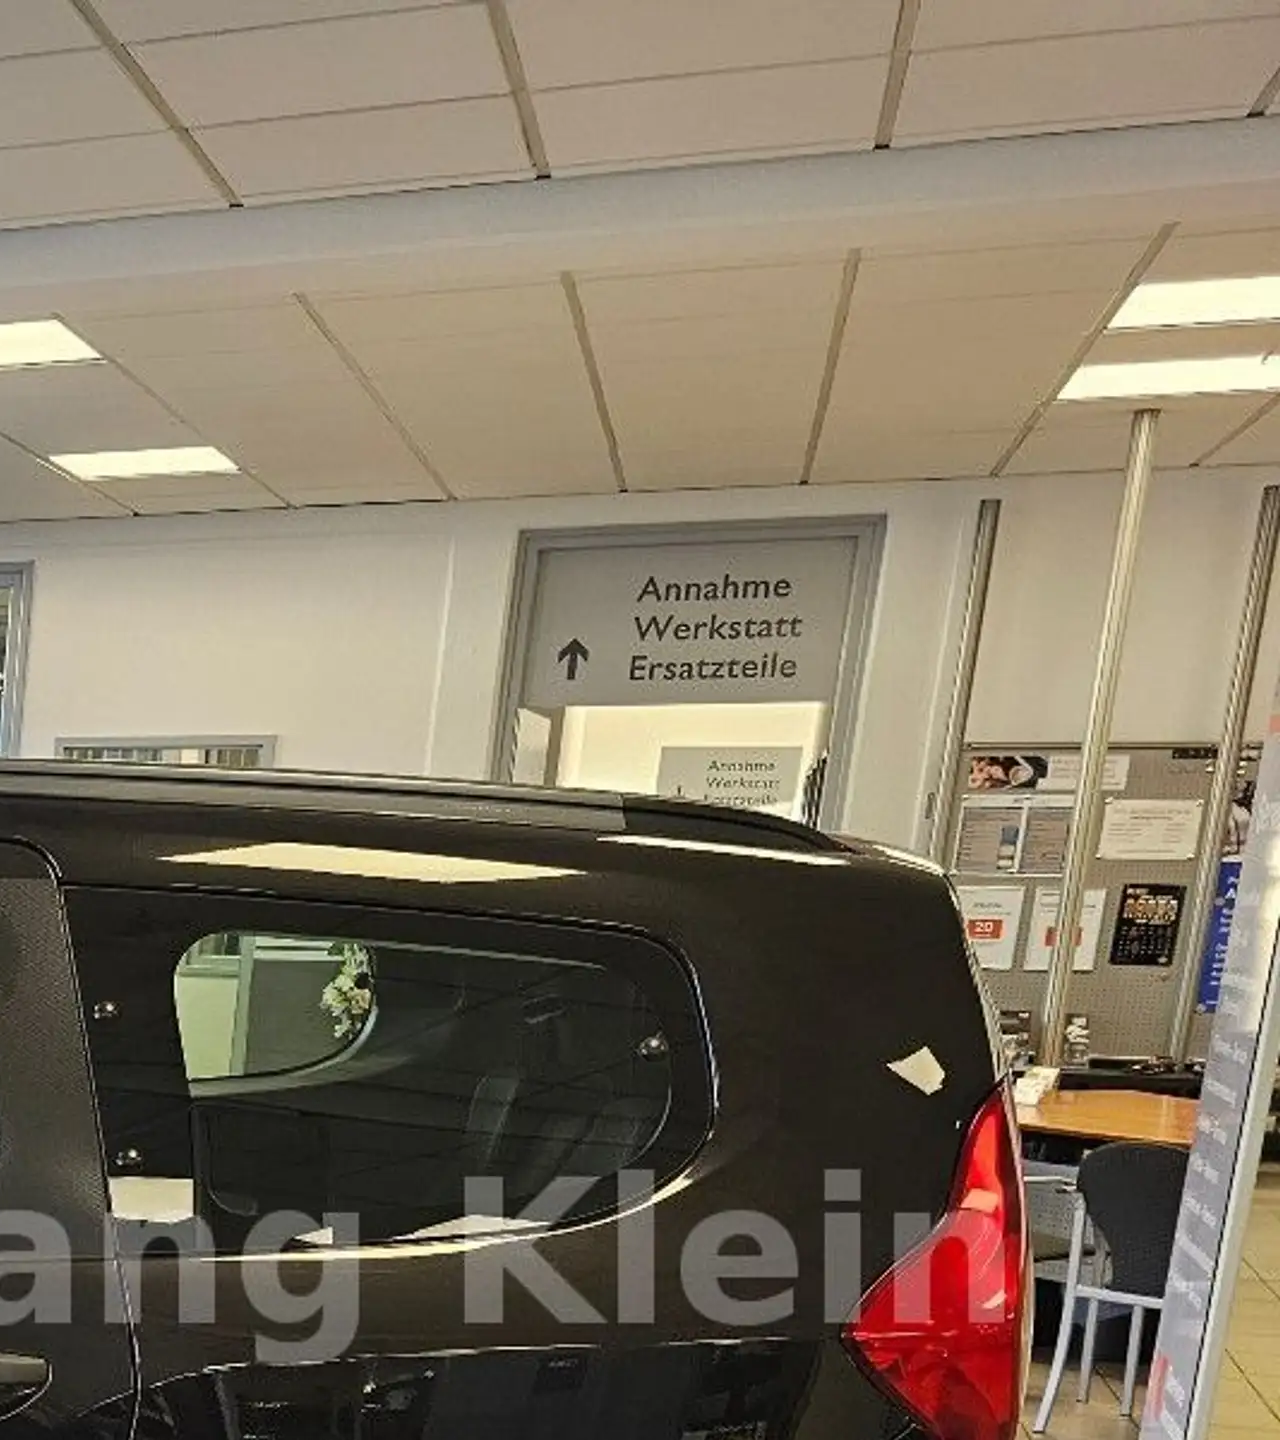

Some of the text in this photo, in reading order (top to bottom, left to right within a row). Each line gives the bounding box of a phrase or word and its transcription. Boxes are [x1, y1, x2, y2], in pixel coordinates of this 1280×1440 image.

[637, 573, 793, 603] Annahme
[634, 614, 804, 642] Werkstatt
[629, 653, 798, 682] Ersatzteile
